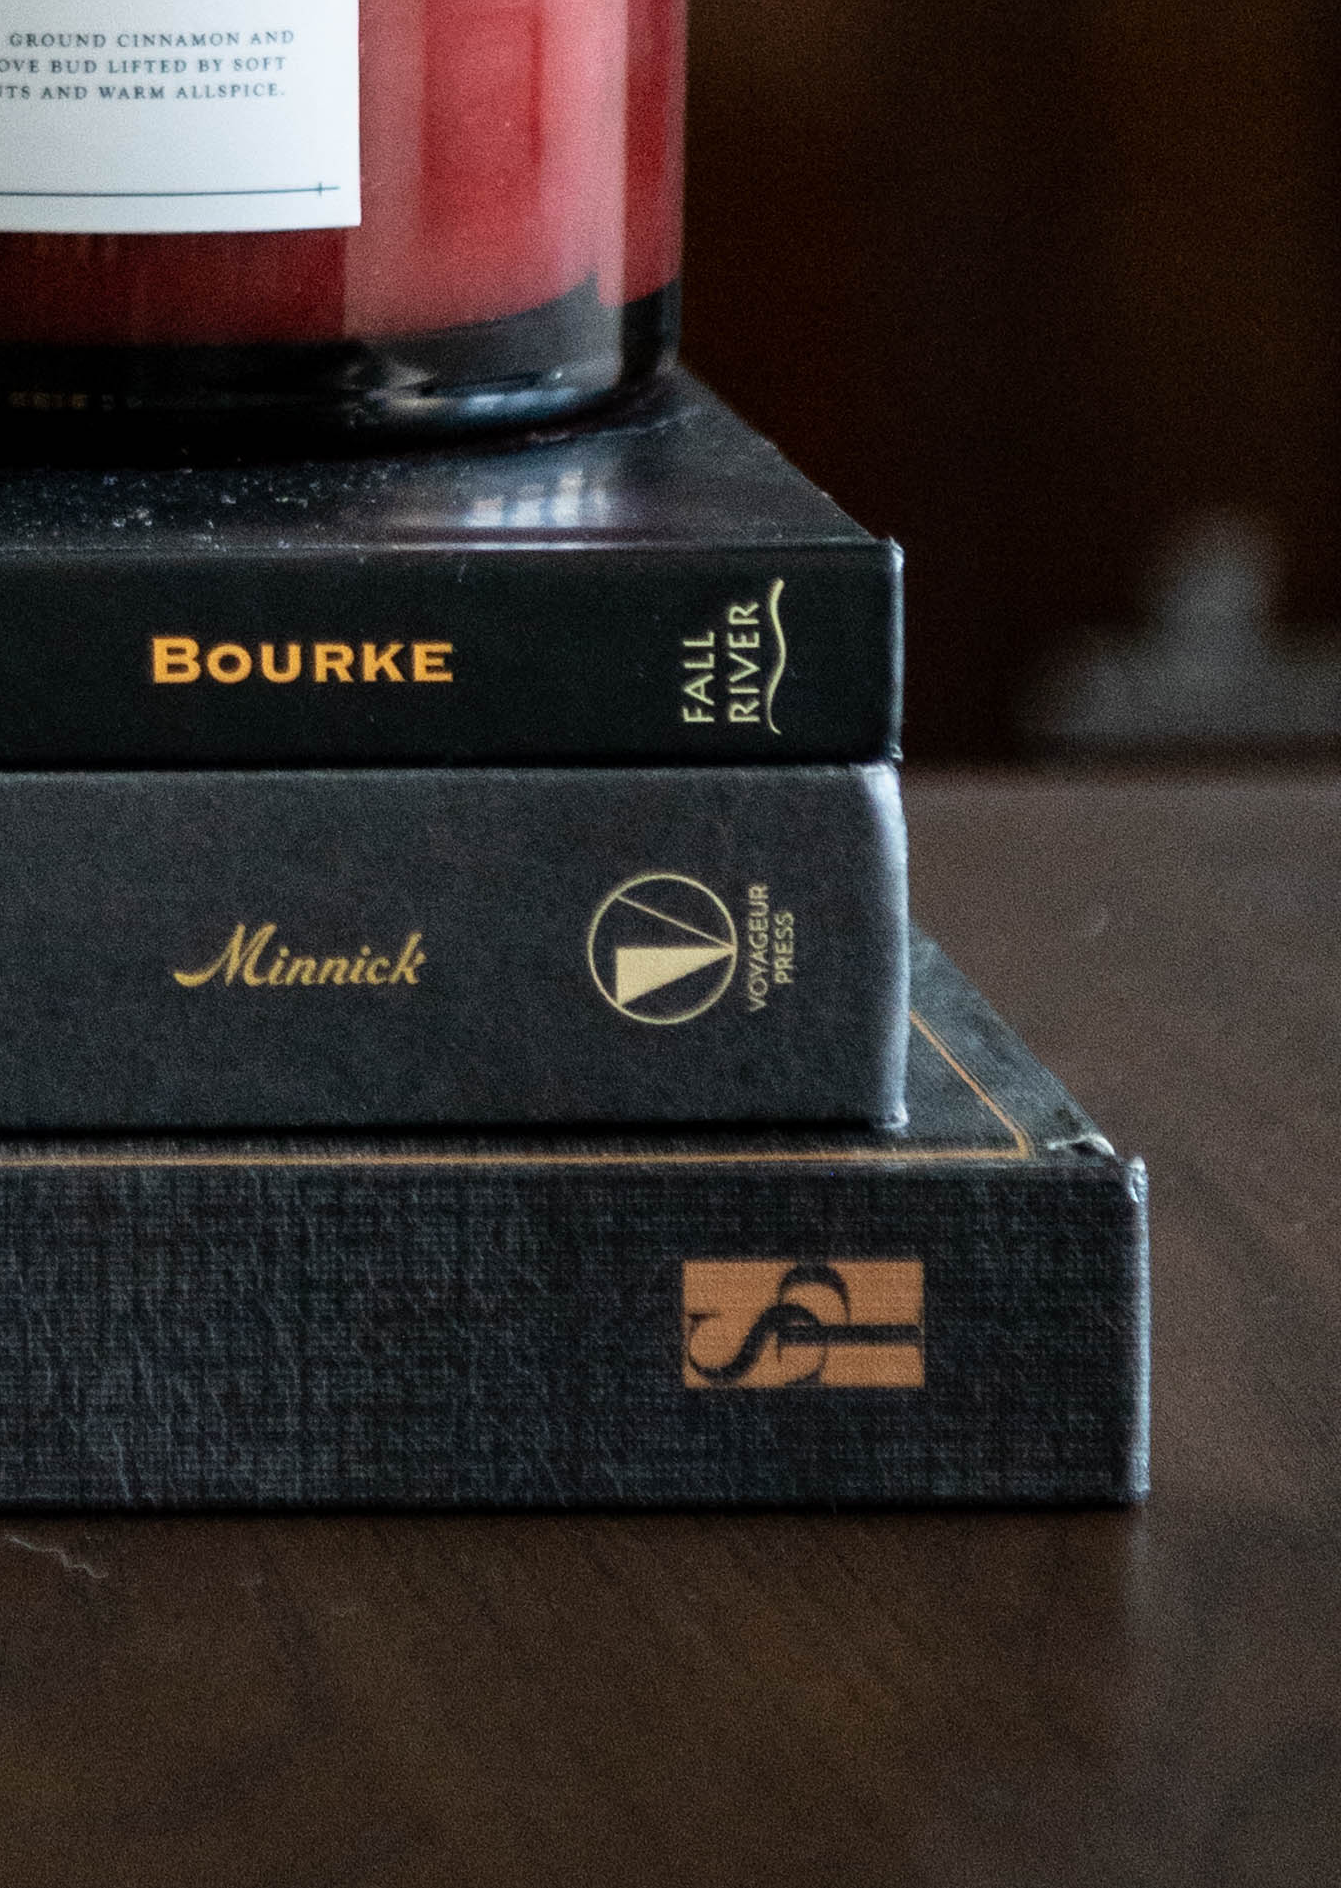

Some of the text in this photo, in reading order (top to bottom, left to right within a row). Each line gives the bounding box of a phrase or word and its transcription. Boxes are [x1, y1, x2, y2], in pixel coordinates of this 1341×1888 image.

[9, 32, 107, 49] GROUND
[117, 31, 241, 49] CINNAMON
[250, 30, 295, 46] AND
[51, 58, 98, 74] BUD
[108, 58, 187, 74] LIFTED
[198, 57, 223, 73] BY
[234, 55, 287, 72] SOFT
[42, 83, 88, 100] AND
[99, 83, 166, 100] WARM
[177, 80, 286, 100] ALLSPICE.
[151, 636, 455, 685] BOURKE
[683, 630, 716, 724] FALL
[728, 600, 762, 724] RIVER
[172, 921, 428, 988] Minnick
[747, 883, 770, 1013] VOYAGEUR
[773, 911, 796, 985] PRESS
